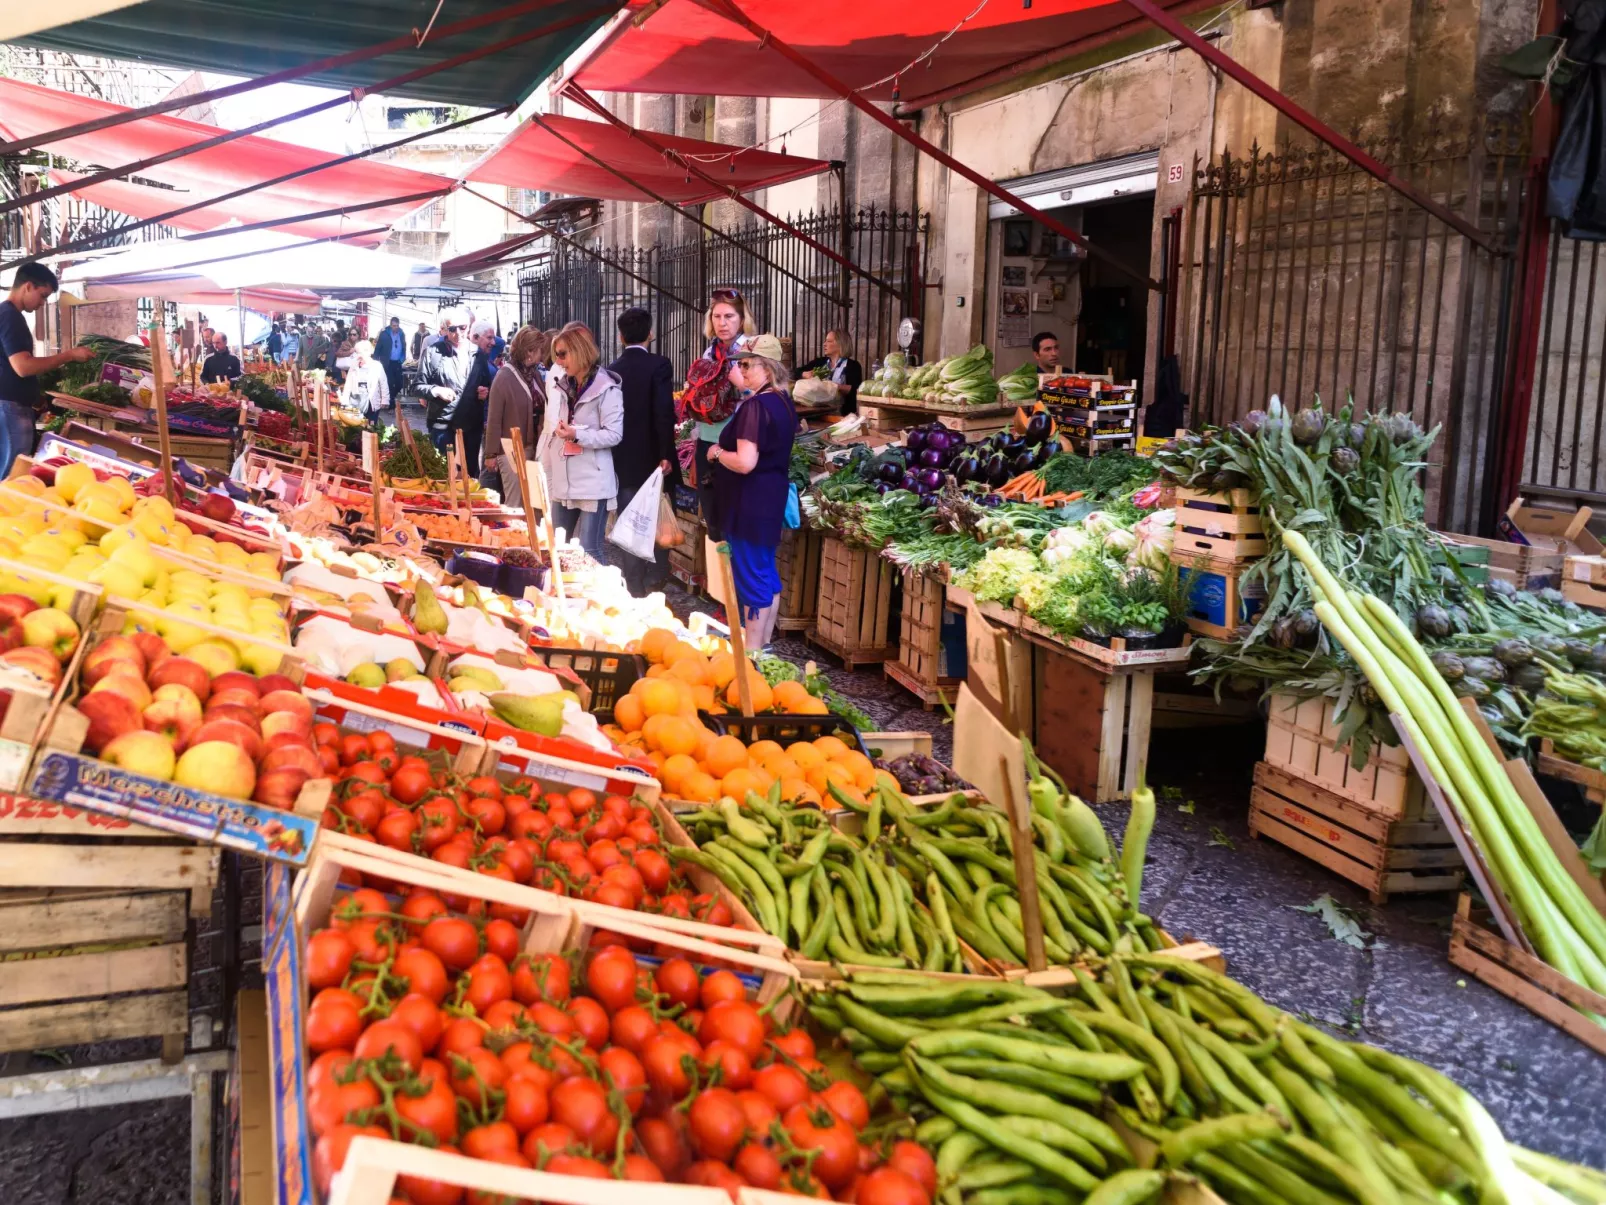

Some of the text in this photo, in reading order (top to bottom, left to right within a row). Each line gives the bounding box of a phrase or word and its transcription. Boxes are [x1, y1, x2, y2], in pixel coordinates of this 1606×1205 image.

[1170, 165, 1182, 181] 59
[1042, 393, 1077, 405] Doppio Gusto
[1060, 424, 1075, 434] Gusto
